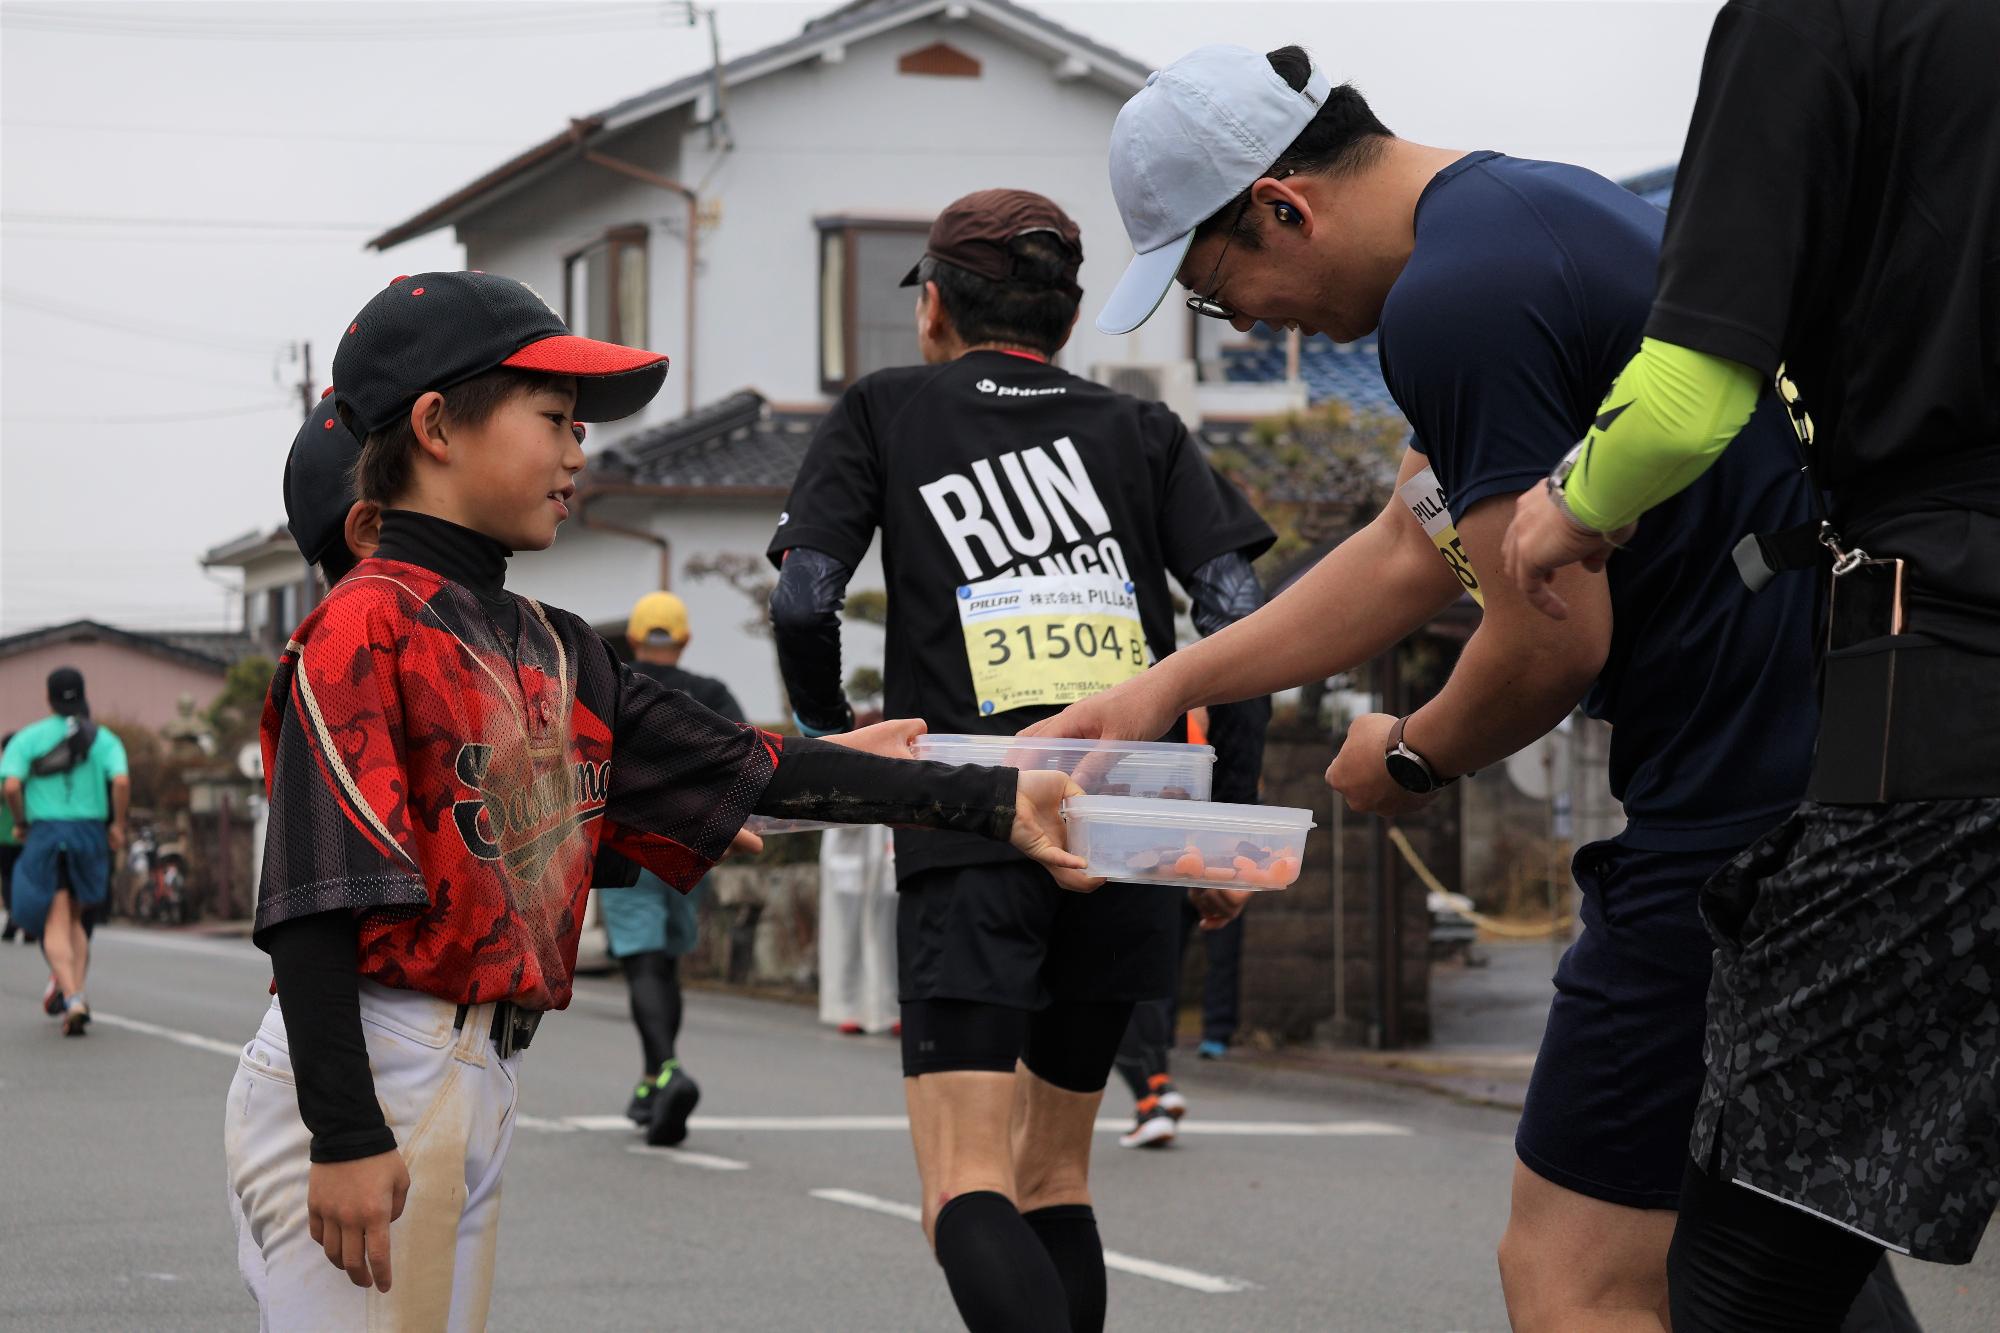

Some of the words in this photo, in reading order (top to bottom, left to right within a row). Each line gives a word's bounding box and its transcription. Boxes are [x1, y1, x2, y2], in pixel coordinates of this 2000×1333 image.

[918, 436, 1112, 581] RUN
[969, 595, 1020, 612] PILLAR
[1030, 592, 1083, 606] 株式会社
[1088, 589, 1134, 610] PILLAR
[983, 622, 1123, 666] 31504
[1130, 638, 1143, 666] B
